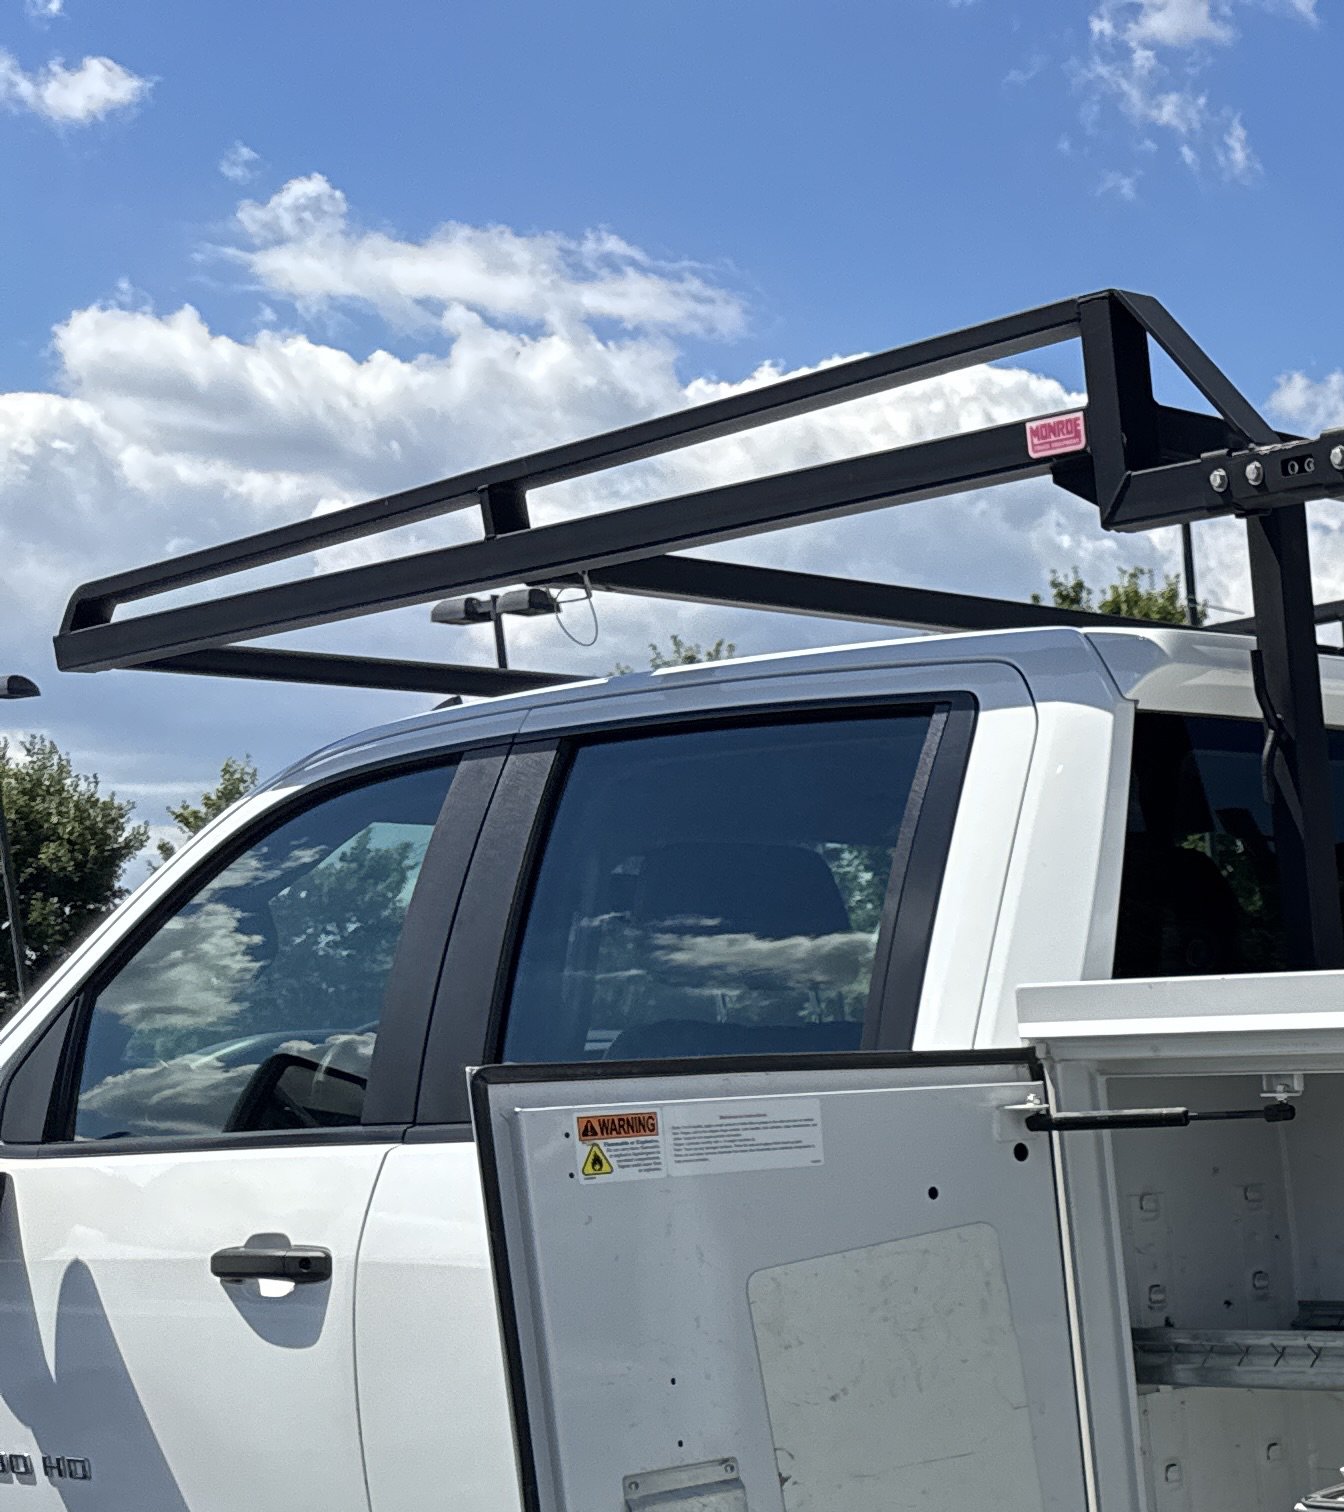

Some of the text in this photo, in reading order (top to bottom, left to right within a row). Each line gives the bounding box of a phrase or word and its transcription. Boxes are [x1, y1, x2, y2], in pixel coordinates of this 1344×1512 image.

[1030, 417, 1081, 441] MONROE
[598, 1115, 656, 1136] WARNING
[42, 1455, 92, 1480] HD
